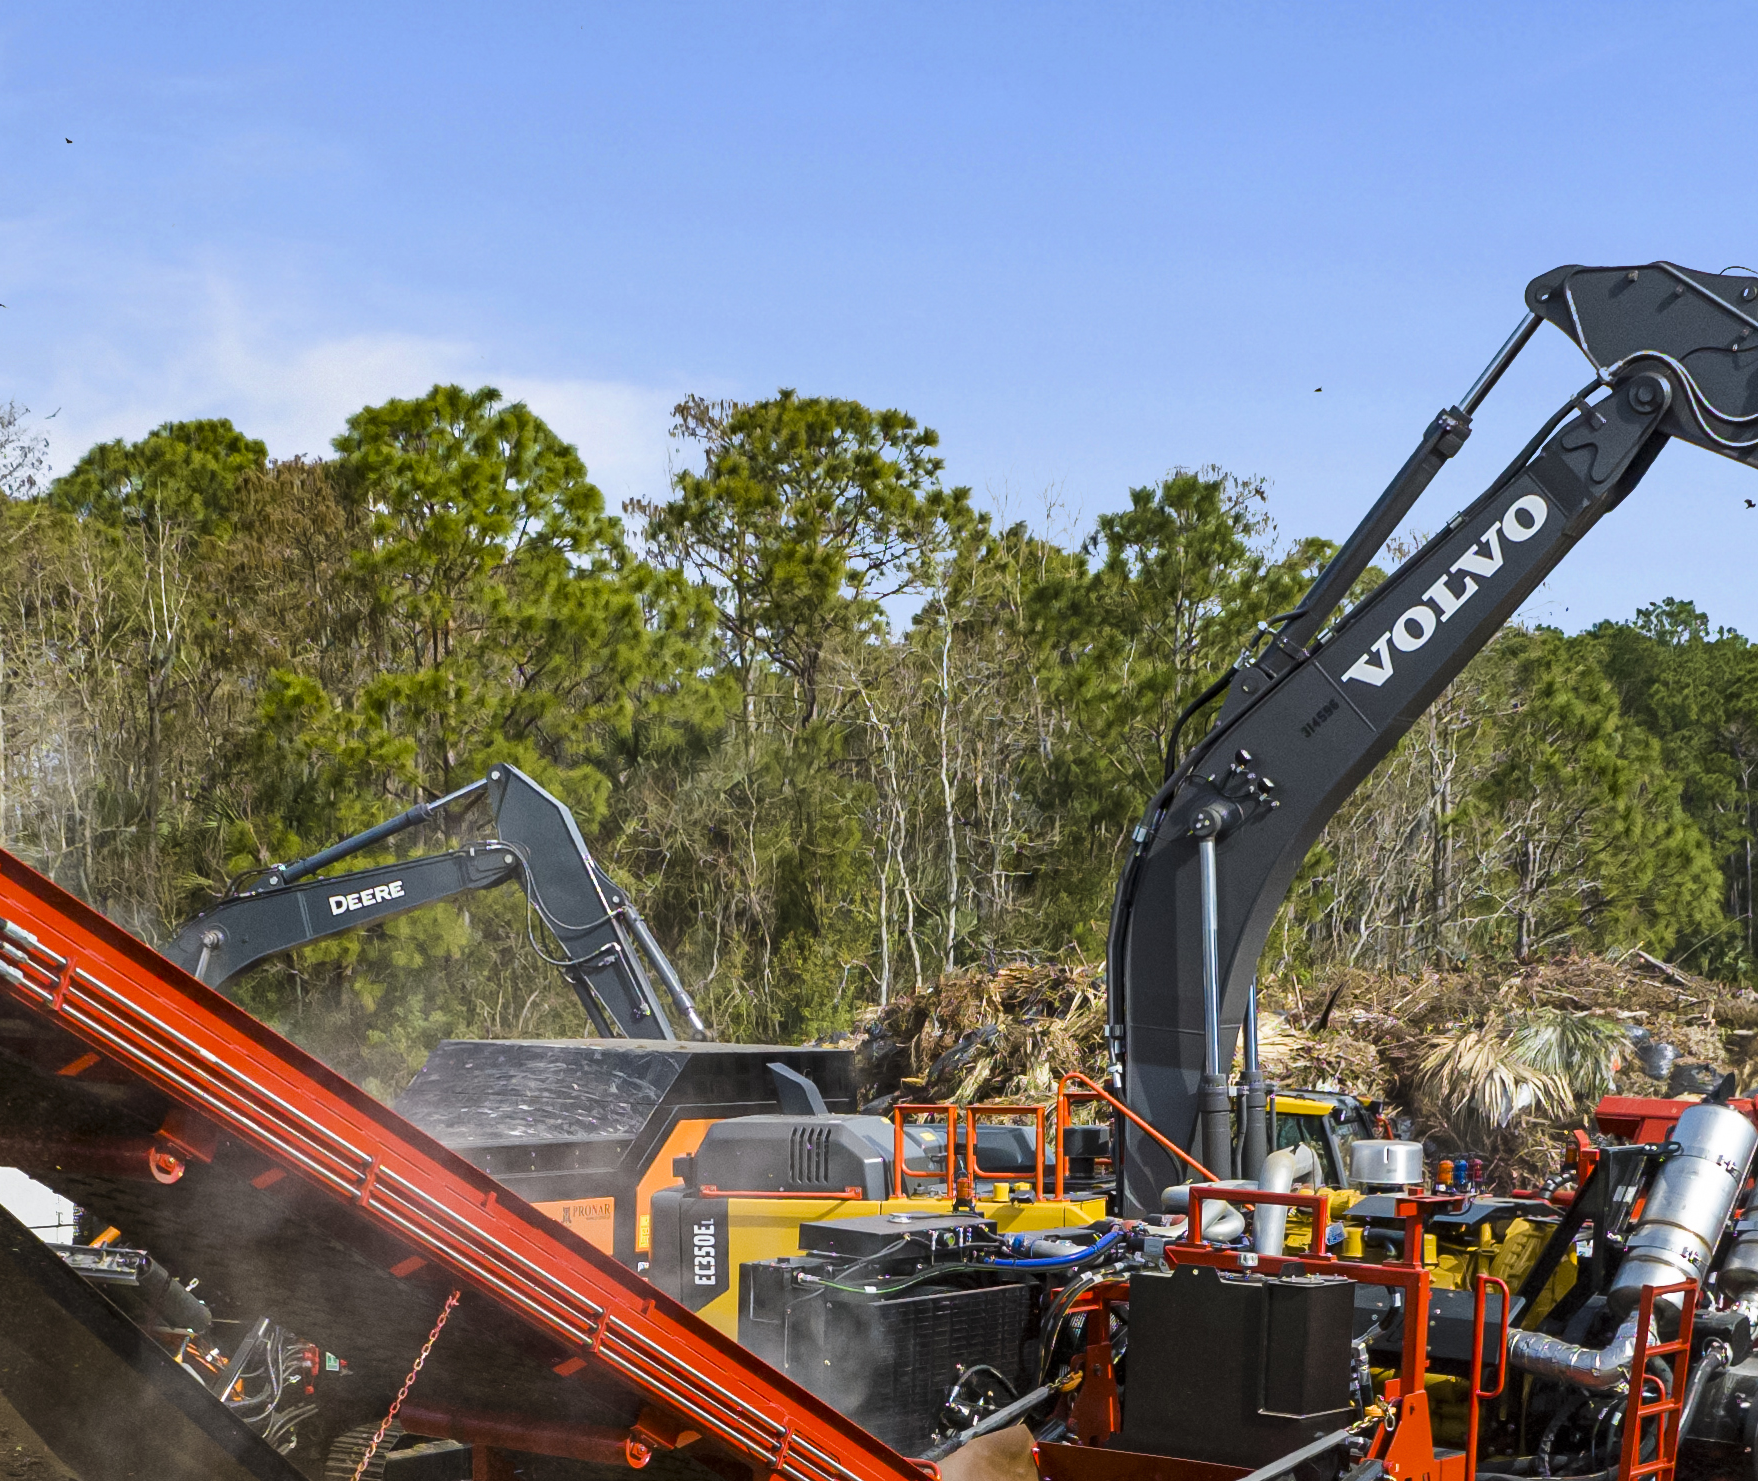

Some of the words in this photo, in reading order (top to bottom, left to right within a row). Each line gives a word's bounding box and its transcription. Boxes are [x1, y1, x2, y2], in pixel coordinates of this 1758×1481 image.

[1340, 494, 1548, 687] VOLVO
[328, 880, 405, 915] DEERE
[573, 1203, 611, 1217] PRONAR
[693, 1218, 716, 1285] EC350EL
